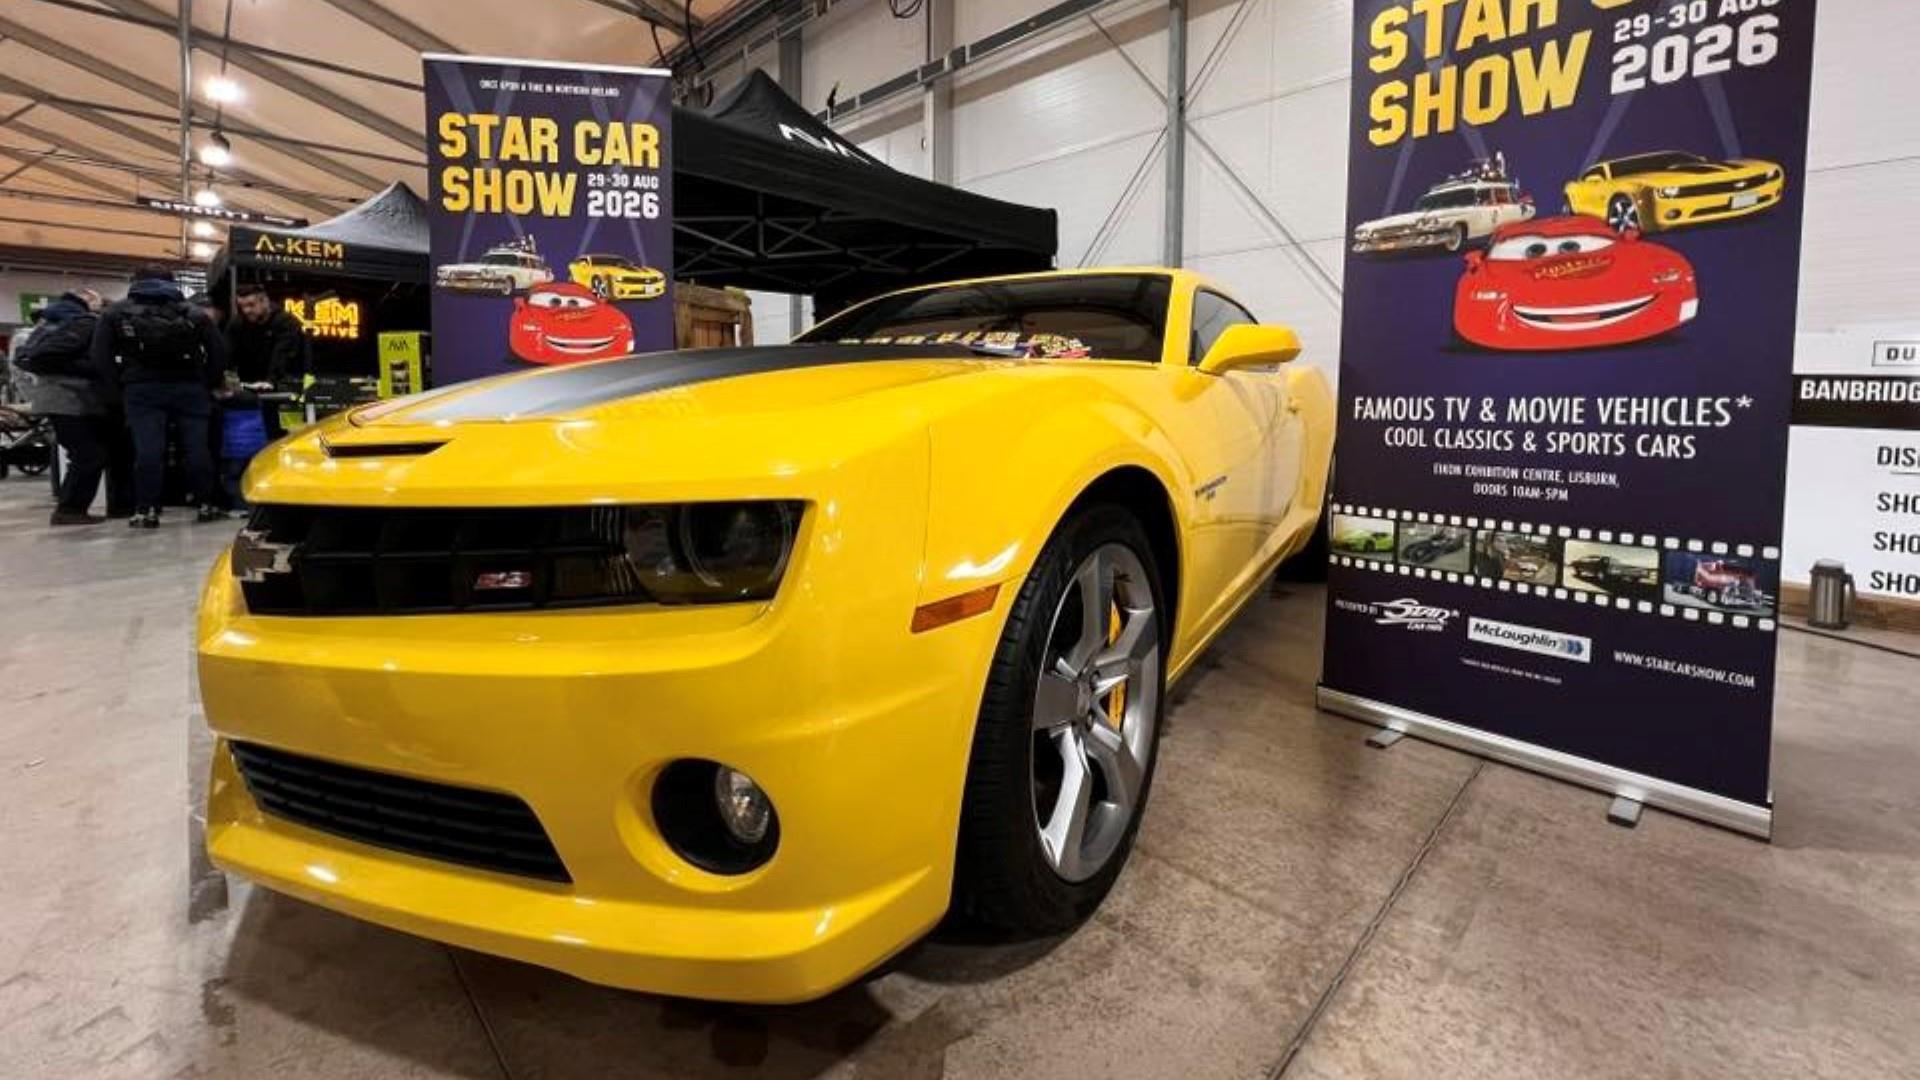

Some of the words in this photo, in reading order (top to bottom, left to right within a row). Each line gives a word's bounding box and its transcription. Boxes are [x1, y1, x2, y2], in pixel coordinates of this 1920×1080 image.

[1613, 0, 1707, 43] 29-30
[1611, 13, 1779, 95] 2026
[1369, 29, 1592, 146] SHOW
[438, 112, 558, 163] STAR
[574, 120, 659, 168] CAR
[442, 166, 577, 217] SHOW
[587, 173, 629, 188] 29-30
[633, 175, 658, 189] AUG
[587, 190, 659, 219] 2026
[255, 254, 344, 268] AUTOMOTIVE
[1354, 396, 1434, 421] FAMOUS
[1444, 397, 1470, 422] TV
[1479, 397, 1496, 422] &
[1507, 397, 1585, 424] MOVIE
[1384, 426, 1427, 447] COOL
[1434, 428, 1513, 451] CLASSICS
[1522, 430, 1537, 452] &
[1546, 431, 1625, 456] SPORTS
[1636, 433, 1696, 459] CARS
[1877, 446, 1920, 467] DIS
[1870, 570, 1920, 594] SHO
[1473, 622, 1557, 647] McLoughlin
[1613, 650, 1755, 688] WWW.STARCARSHOW.COM
